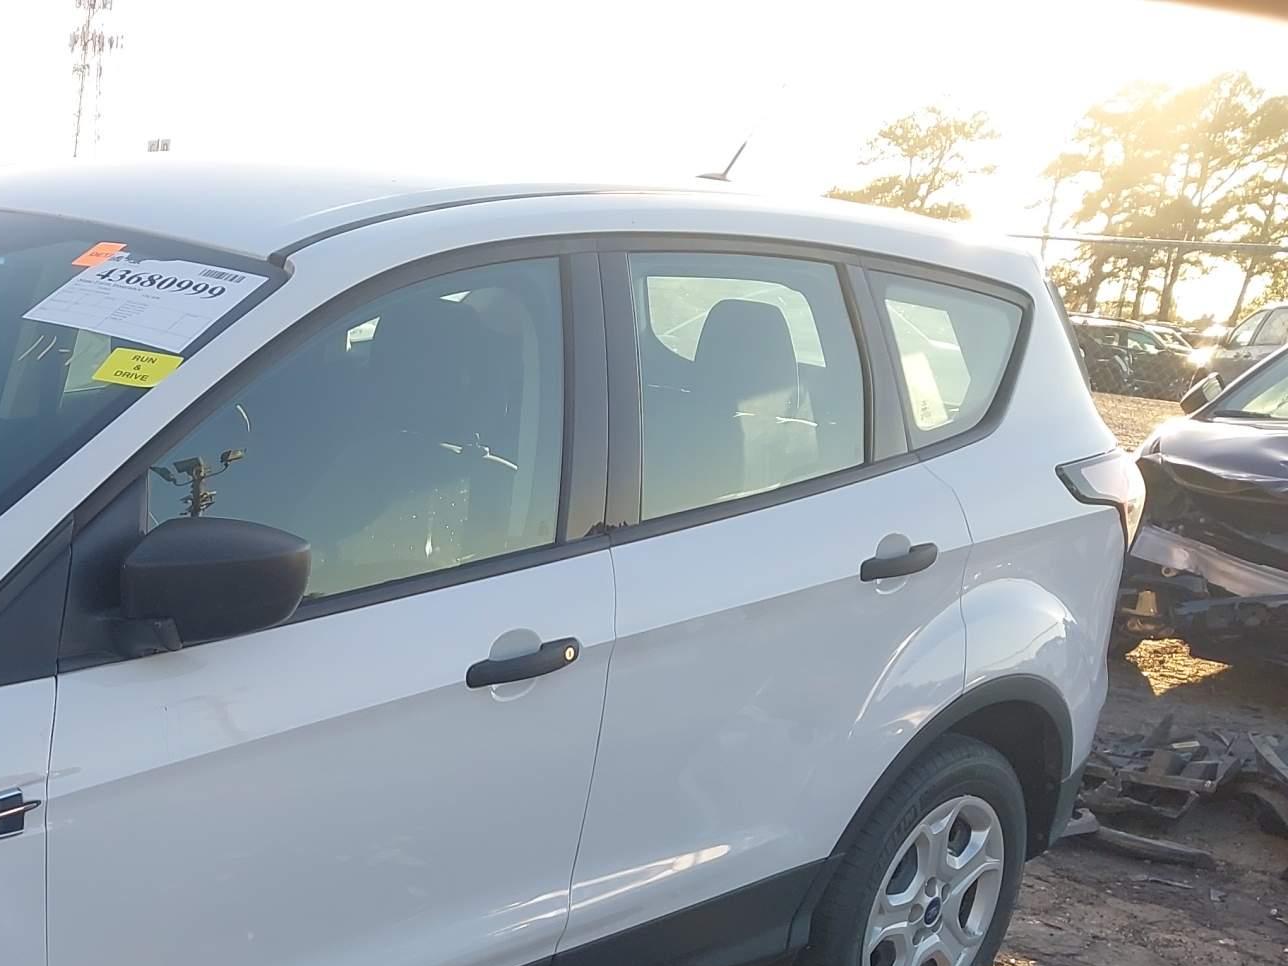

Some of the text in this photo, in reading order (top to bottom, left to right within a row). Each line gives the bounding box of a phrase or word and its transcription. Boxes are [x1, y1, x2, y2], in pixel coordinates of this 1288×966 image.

[96, 267, 226, 300] 43680999
[131, 354, 158, 365] RUN
[113, 370, 149, 382] DRIVE
